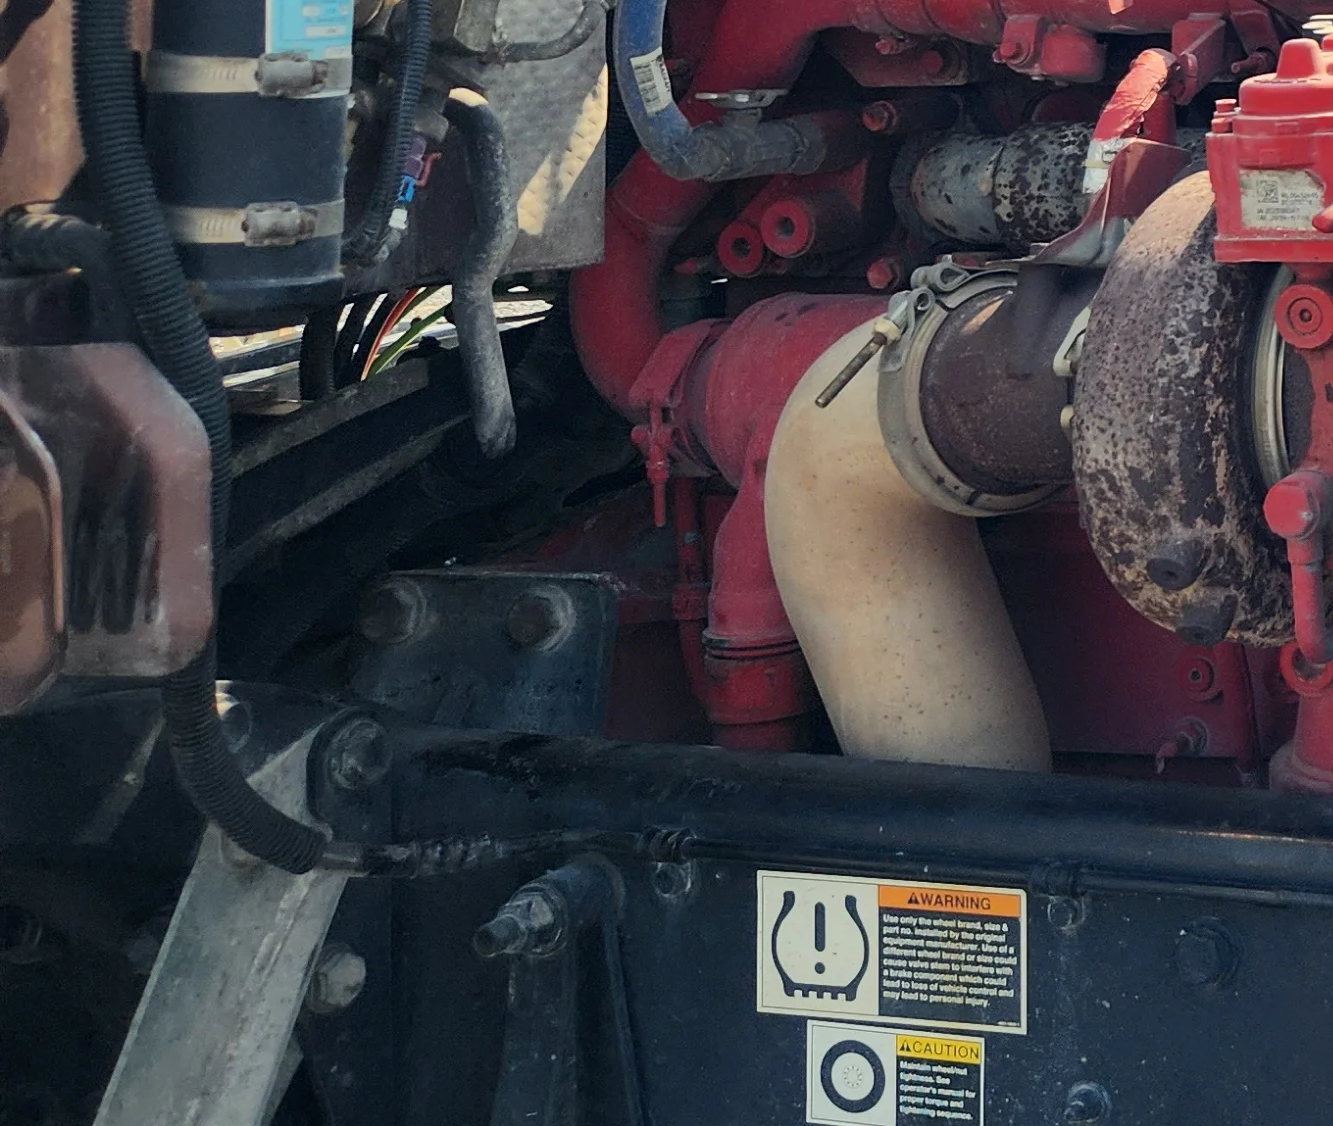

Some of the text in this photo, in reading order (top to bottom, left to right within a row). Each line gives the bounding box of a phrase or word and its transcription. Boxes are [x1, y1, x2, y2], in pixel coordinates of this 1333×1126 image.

[920, 894, 991, 910] WARNING
[883, 914, 898, 923] Use
[900, 917, 917, 926] only
[933, 919, 956, 927] wheel
[958, 921, 982, 930] brand,
[984, 923, 1000, 931] size
[883, 926, 899, 934] part
[950, 931, 959, 940] by
[883, 937, 924, 946] equipment
[982, 944, 997, 952] Use
[999, 945, 1007, 953] of
[883, 947, 916, 956] different
[918, 950, 940, 958] wheel
[942, 952, 965, 960] brand
[890, 969, 912, 978] brake
[959, 975, 982, 983] which
[996, 967, 1013, 975] with
[883, 979, 900, 987] lead
[912, 982, 928, 990] loss
[940, 985, 967, 993] vehicle
[883, 991, 900, 1000] may
[901, 991, 918, 1000] lead
[966, 997, 990, 1007] injury.
[913, 1041, 979, 1060] CAUTION
